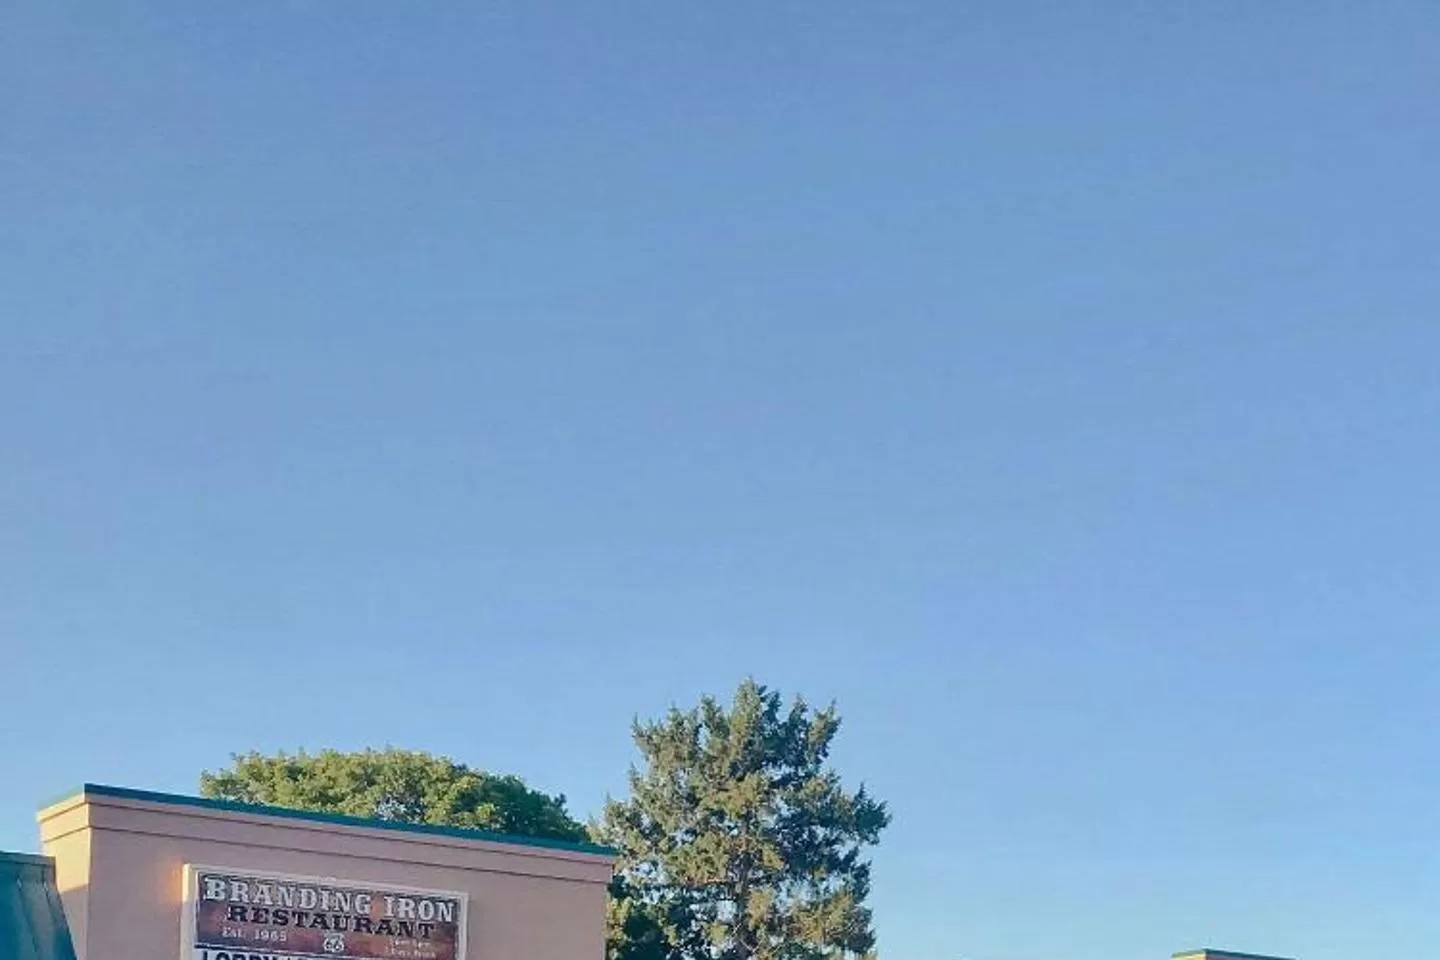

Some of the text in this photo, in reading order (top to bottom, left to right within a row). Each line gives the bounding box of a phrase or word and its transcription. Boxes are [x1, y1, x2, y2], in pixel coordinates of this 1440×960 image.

[204, 877, 455, 923] BRANDING IRON
[227, 906, 435, 940] RESTAURANT
